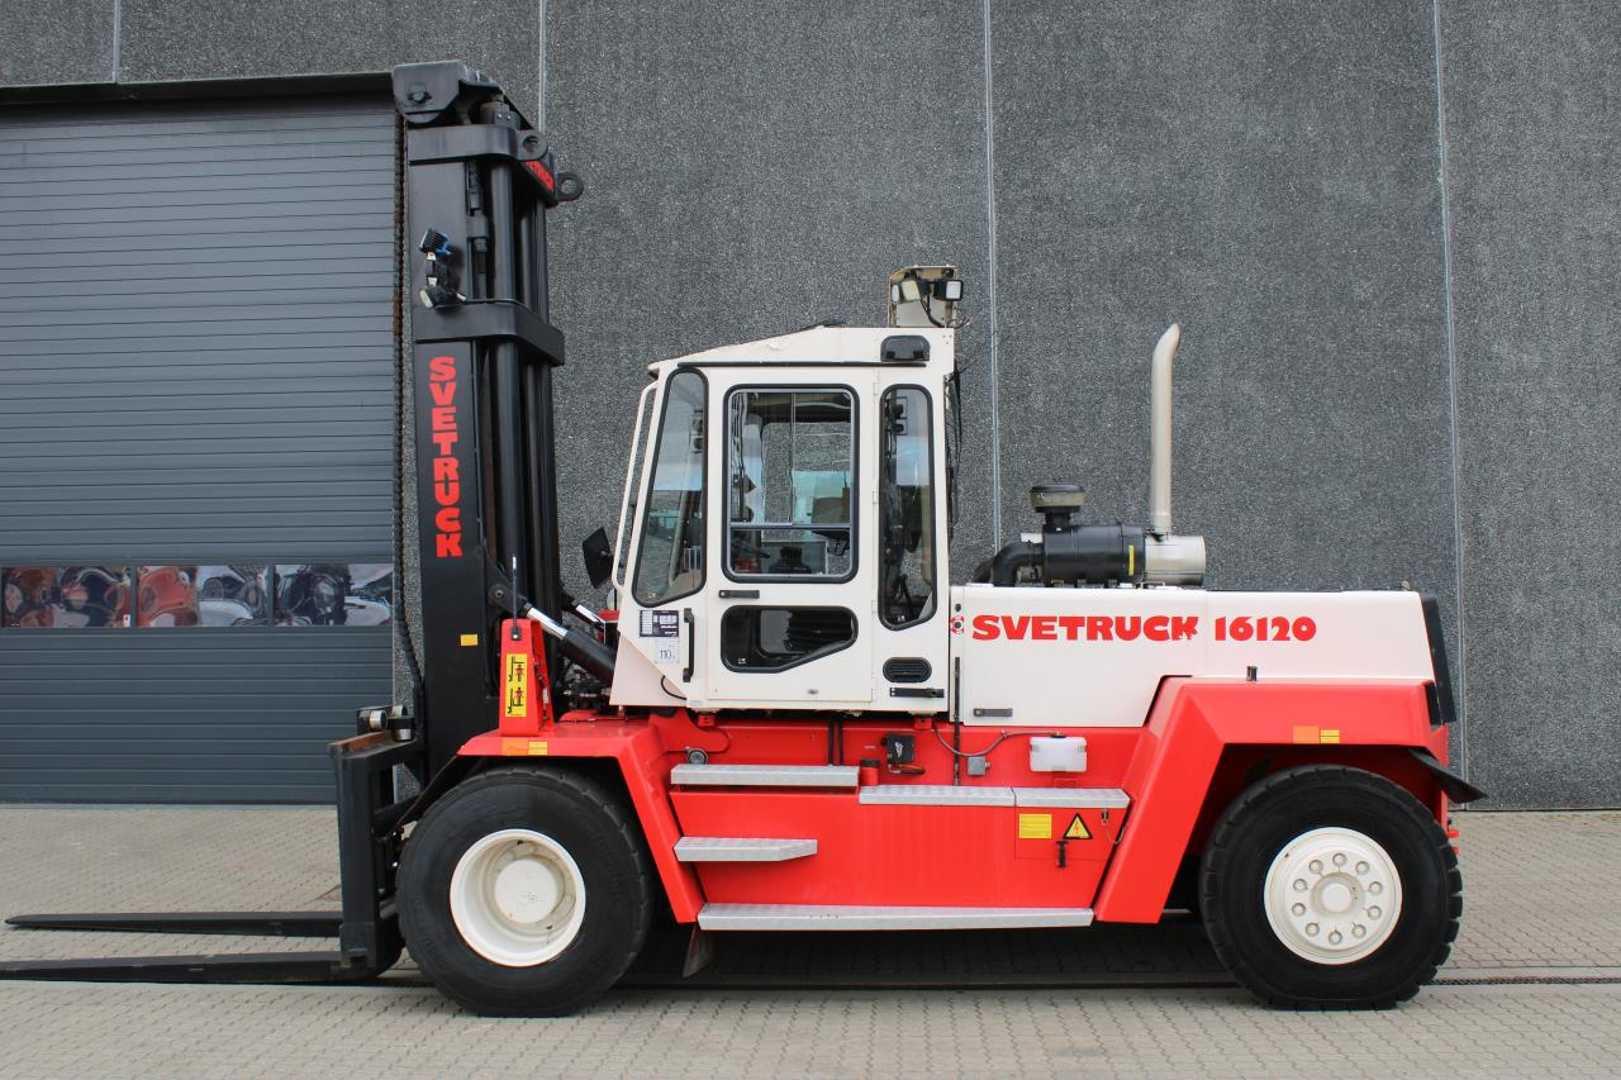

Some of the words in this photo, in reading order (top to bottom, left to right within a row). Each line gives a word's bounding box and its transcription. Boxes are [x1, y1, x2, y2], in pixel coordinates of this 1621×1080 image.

[429, 356, 463, 558] SVETRUCK
[972, 614, 1199, 642] SVETRUCK
[1214, 616, 1318, 642] 16120
